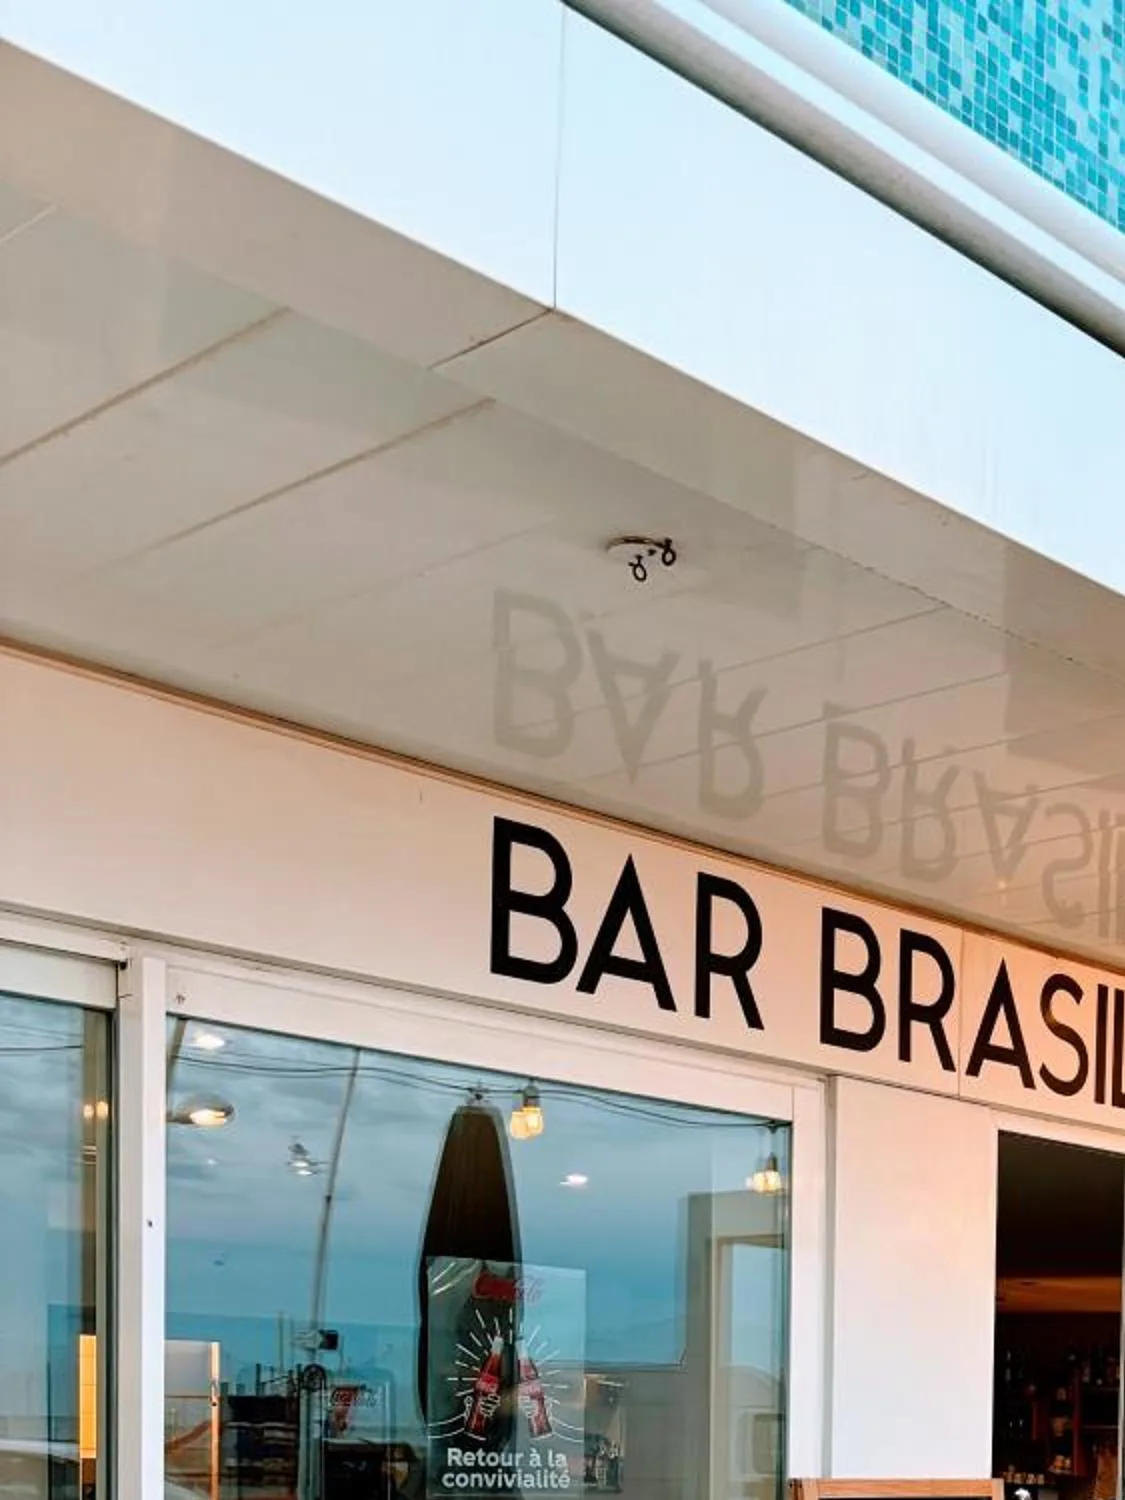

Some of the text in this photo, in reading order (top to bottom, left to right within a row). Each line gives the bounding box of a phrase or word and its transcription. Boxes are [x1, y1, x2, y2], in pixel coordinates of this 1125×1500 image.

[490, 816, 764, 1031] BAR
[447, 1447, 568, 1468] Retour à la
[442, 1468, 571, 1489] convivialité
